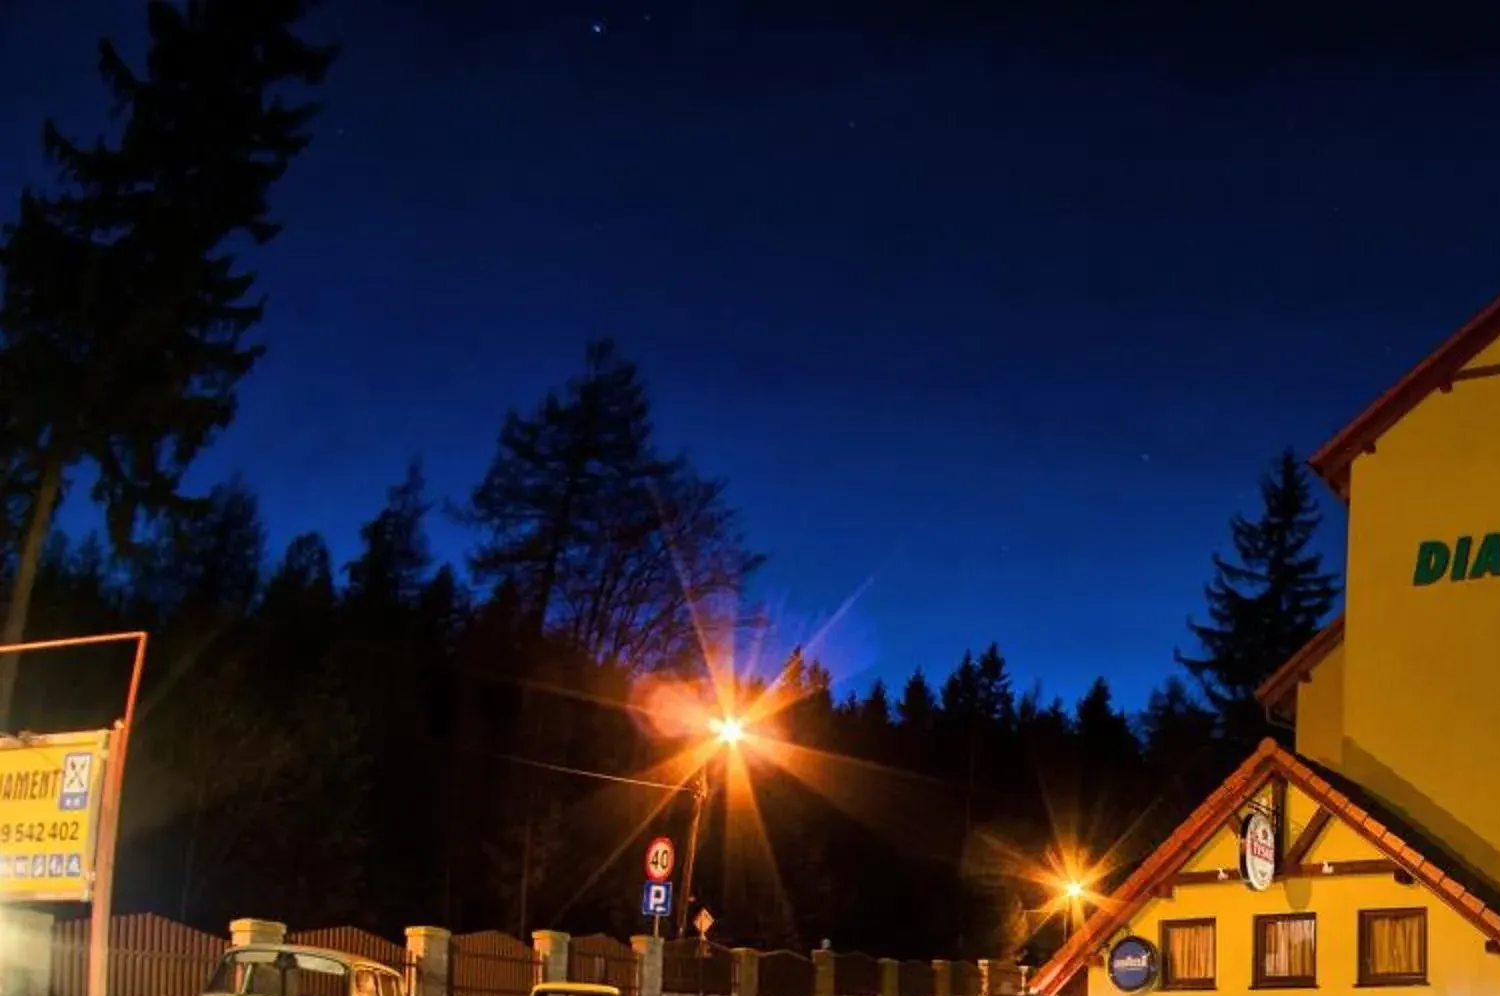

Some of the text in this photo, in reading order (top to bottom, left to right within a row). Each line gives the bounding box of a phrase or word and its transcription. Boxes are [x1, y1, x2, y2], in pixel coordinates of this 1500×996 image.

[15, 822, 45, 842] 542
[48, 820, 80, 841] 402
[649, 848, 669, 870] 40
[649, 884, 667, 911] P
